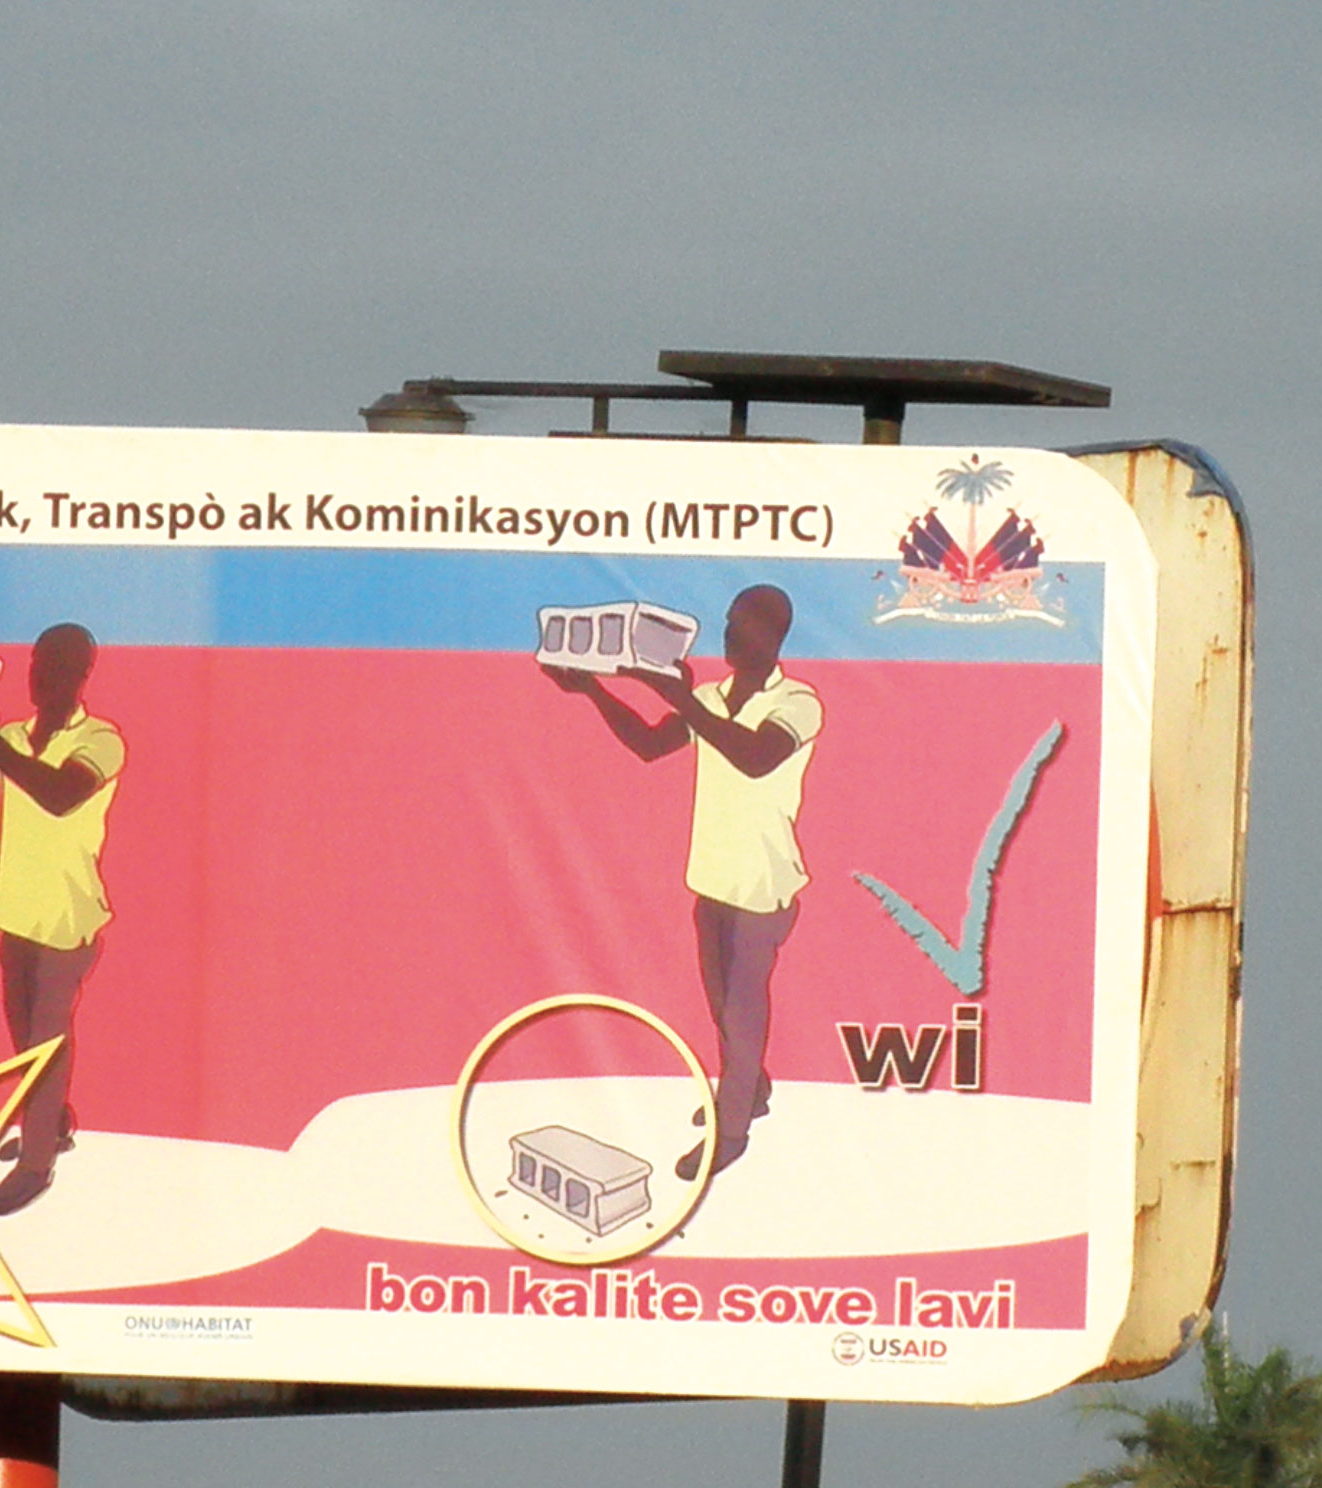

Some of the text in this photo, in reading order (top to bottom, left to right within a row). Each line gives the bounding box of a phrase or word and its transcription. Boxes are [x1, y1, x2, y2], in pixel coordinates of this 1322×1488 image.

[43, 492, 226, 540] Transpò
[237, 492, 292, 531] ak
[306, 492, 630, 547] Kominikasyon
[644, 500, 834, 549] (MTPTC)
[835, 1002, 987, 1093] wi
[368, 1263, 1016, 1329] bon kalite sove lavi
[869, 1338, 948, 1359] USAID
